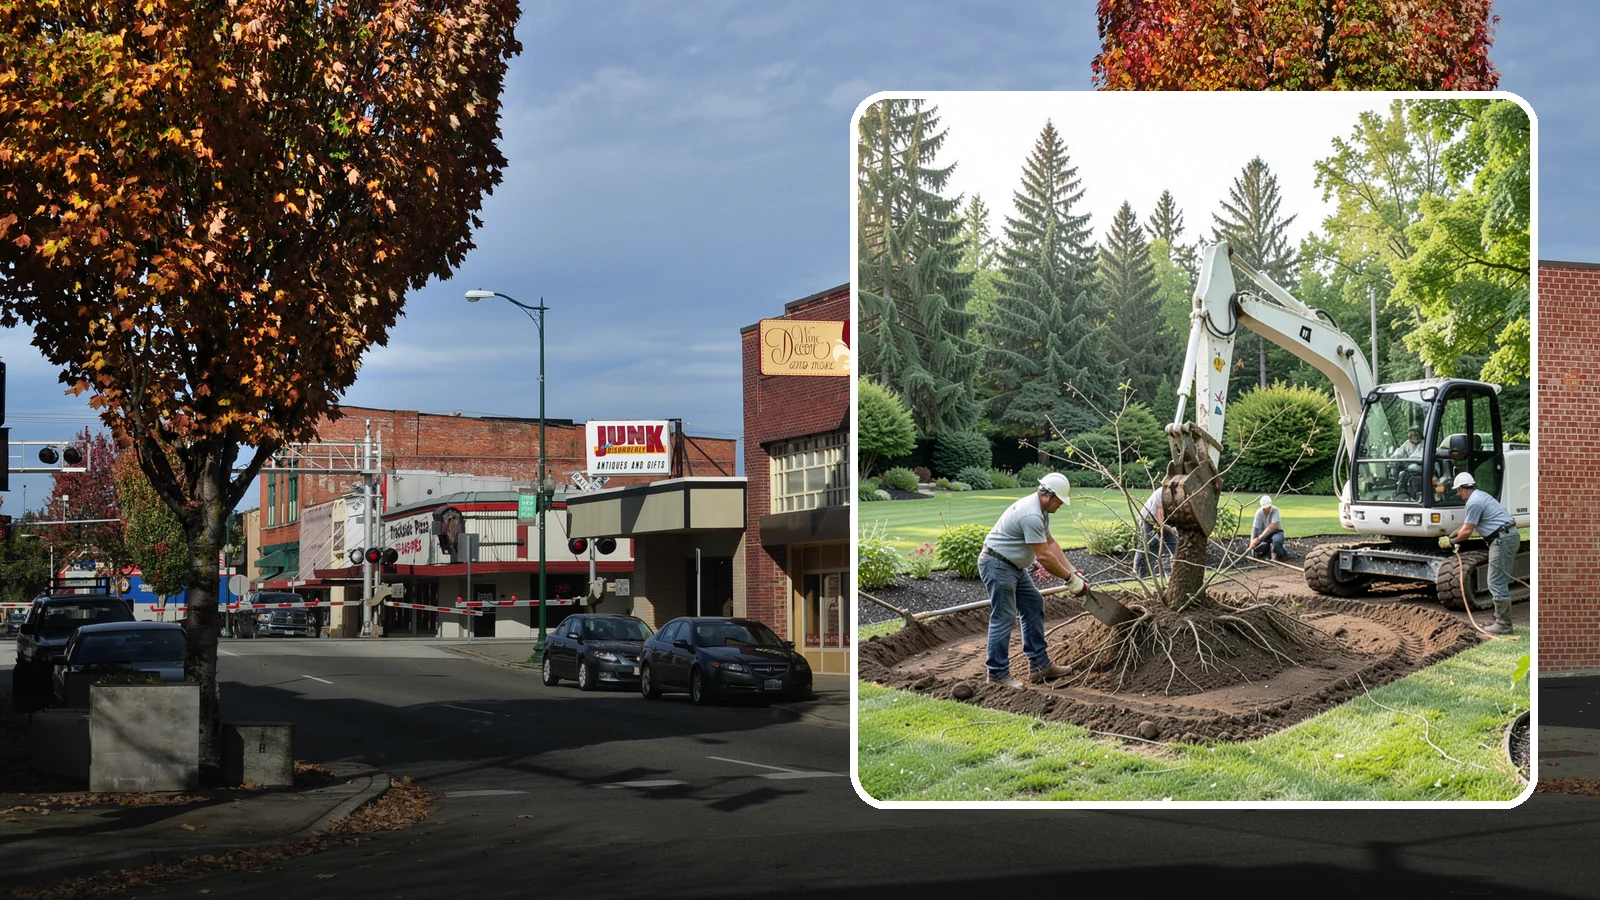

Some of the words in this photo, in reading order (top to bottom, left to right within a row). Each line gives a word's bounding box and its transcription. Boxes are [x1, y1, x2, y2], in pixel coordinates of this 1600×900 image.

[596, 425, 665, 457] JUNK
[607, 446, 646, 454] DISORDERLY
[596, 460, 628, 470] ANTIQUES
[631, 460, 644, 470] AND
[646, 460, 666, 470] GIFTS
[590, 476, 608, 491] SING
[414, 519, 429, 534] Pizza
